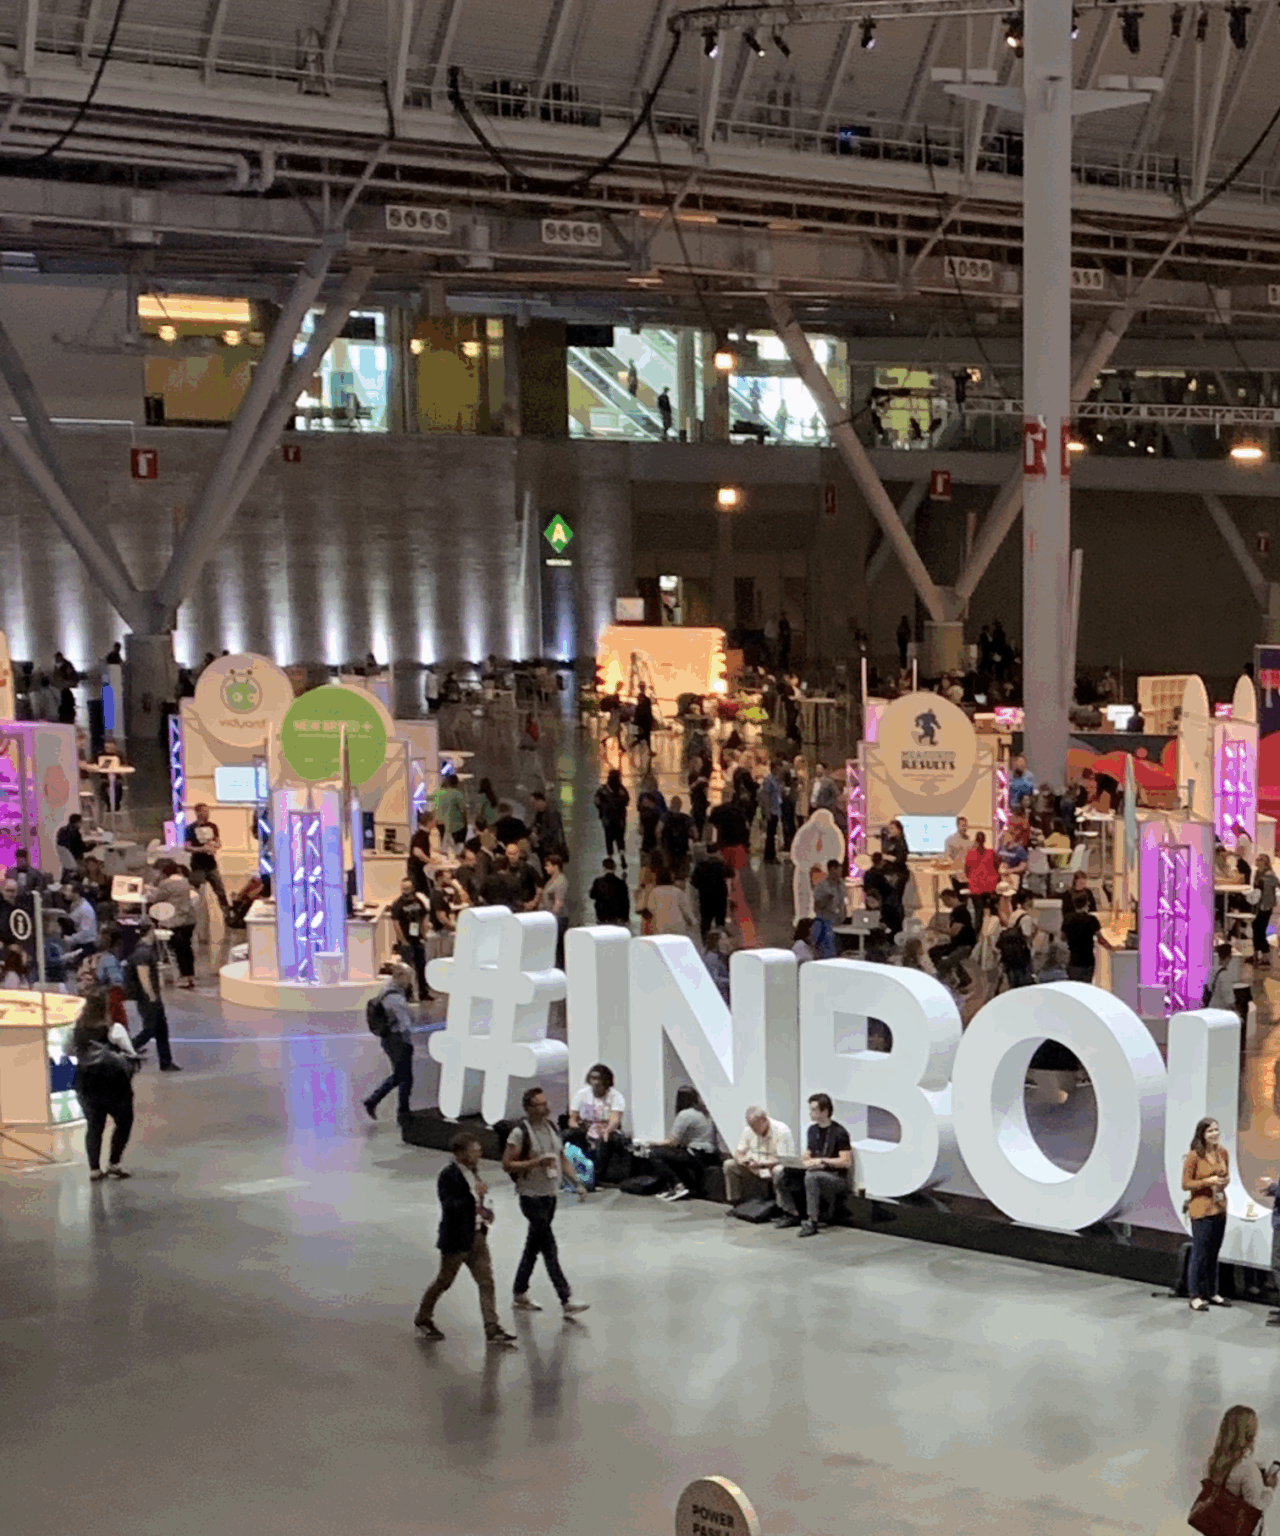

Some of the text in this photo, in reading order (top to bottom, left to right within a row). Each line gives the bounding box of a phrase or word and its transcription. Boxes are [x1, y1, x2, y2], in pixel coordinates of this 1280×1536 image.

[551, 523, 568, 543] A
[901, 760, 956, 770] RESULTS
[692, 1504, 735, 1529] POWER
